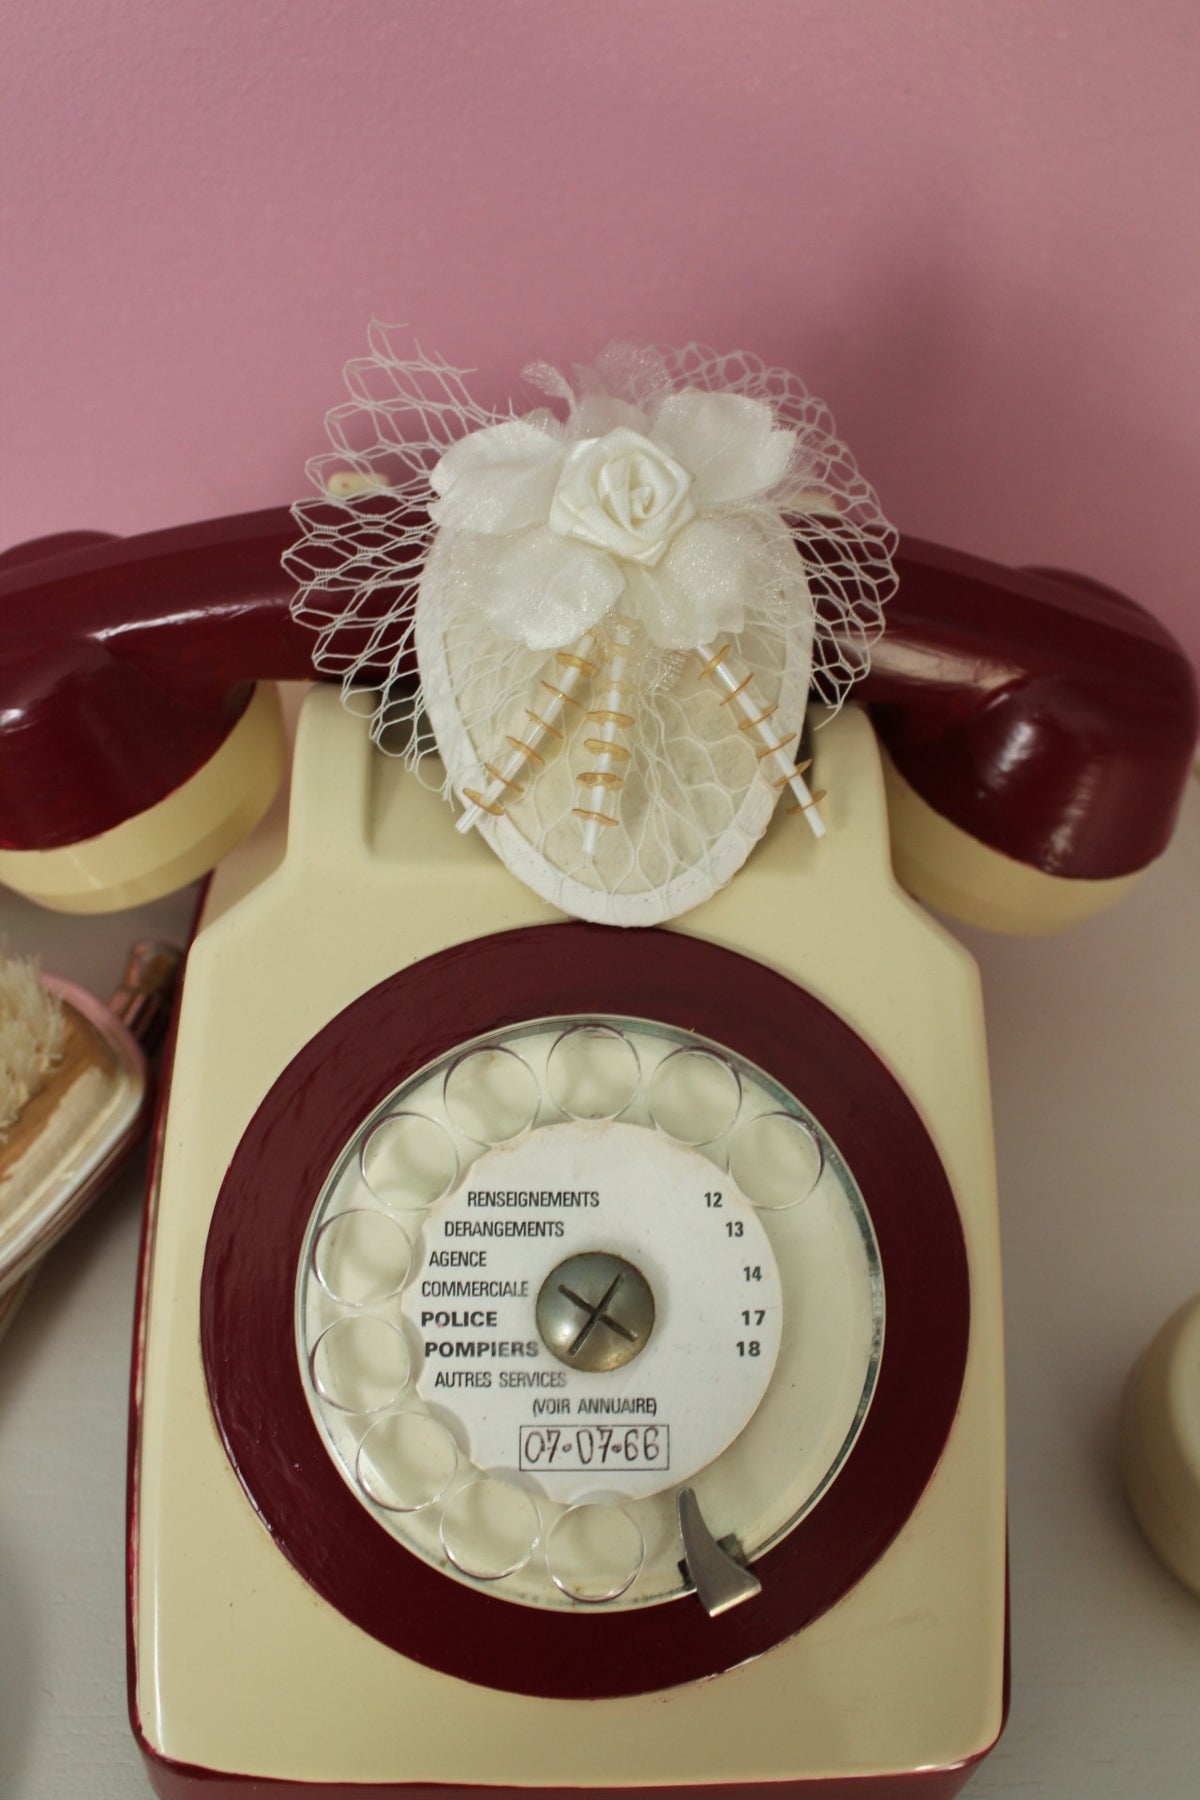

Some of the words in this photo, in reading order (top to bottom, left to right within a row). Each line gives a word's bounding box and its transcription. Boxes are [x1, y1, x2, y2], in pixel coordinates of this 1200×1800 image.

[468, 1191, 600, 1208] RENSEIGNEMENTS
[705, 1192, 722, 1208] 12
[444, 1221, 564, 1237] DERANGEMENTS
[726, 1222, 744, 1238] 13
[429, 1251, 487, 1267] AGENCE
[744, 1266, 762, 1282] 14
[421, 1281, 528, 1297] COMMERCIALE
[421, 1311, 498, 1327] POLICE
[741, 1311, 765, 1326] 17
[424, 1342, 539, 1358] POMPIERS
[736, 1342, 761, 1357] 18
[435, 1372, 492, 1388] AUTRES
[499, 1372, 567, 1388] SERVICES
[533, 1398, 570, 1415] (VOIR
[578, 1398, 657, 1416] ANNUAIRE)
